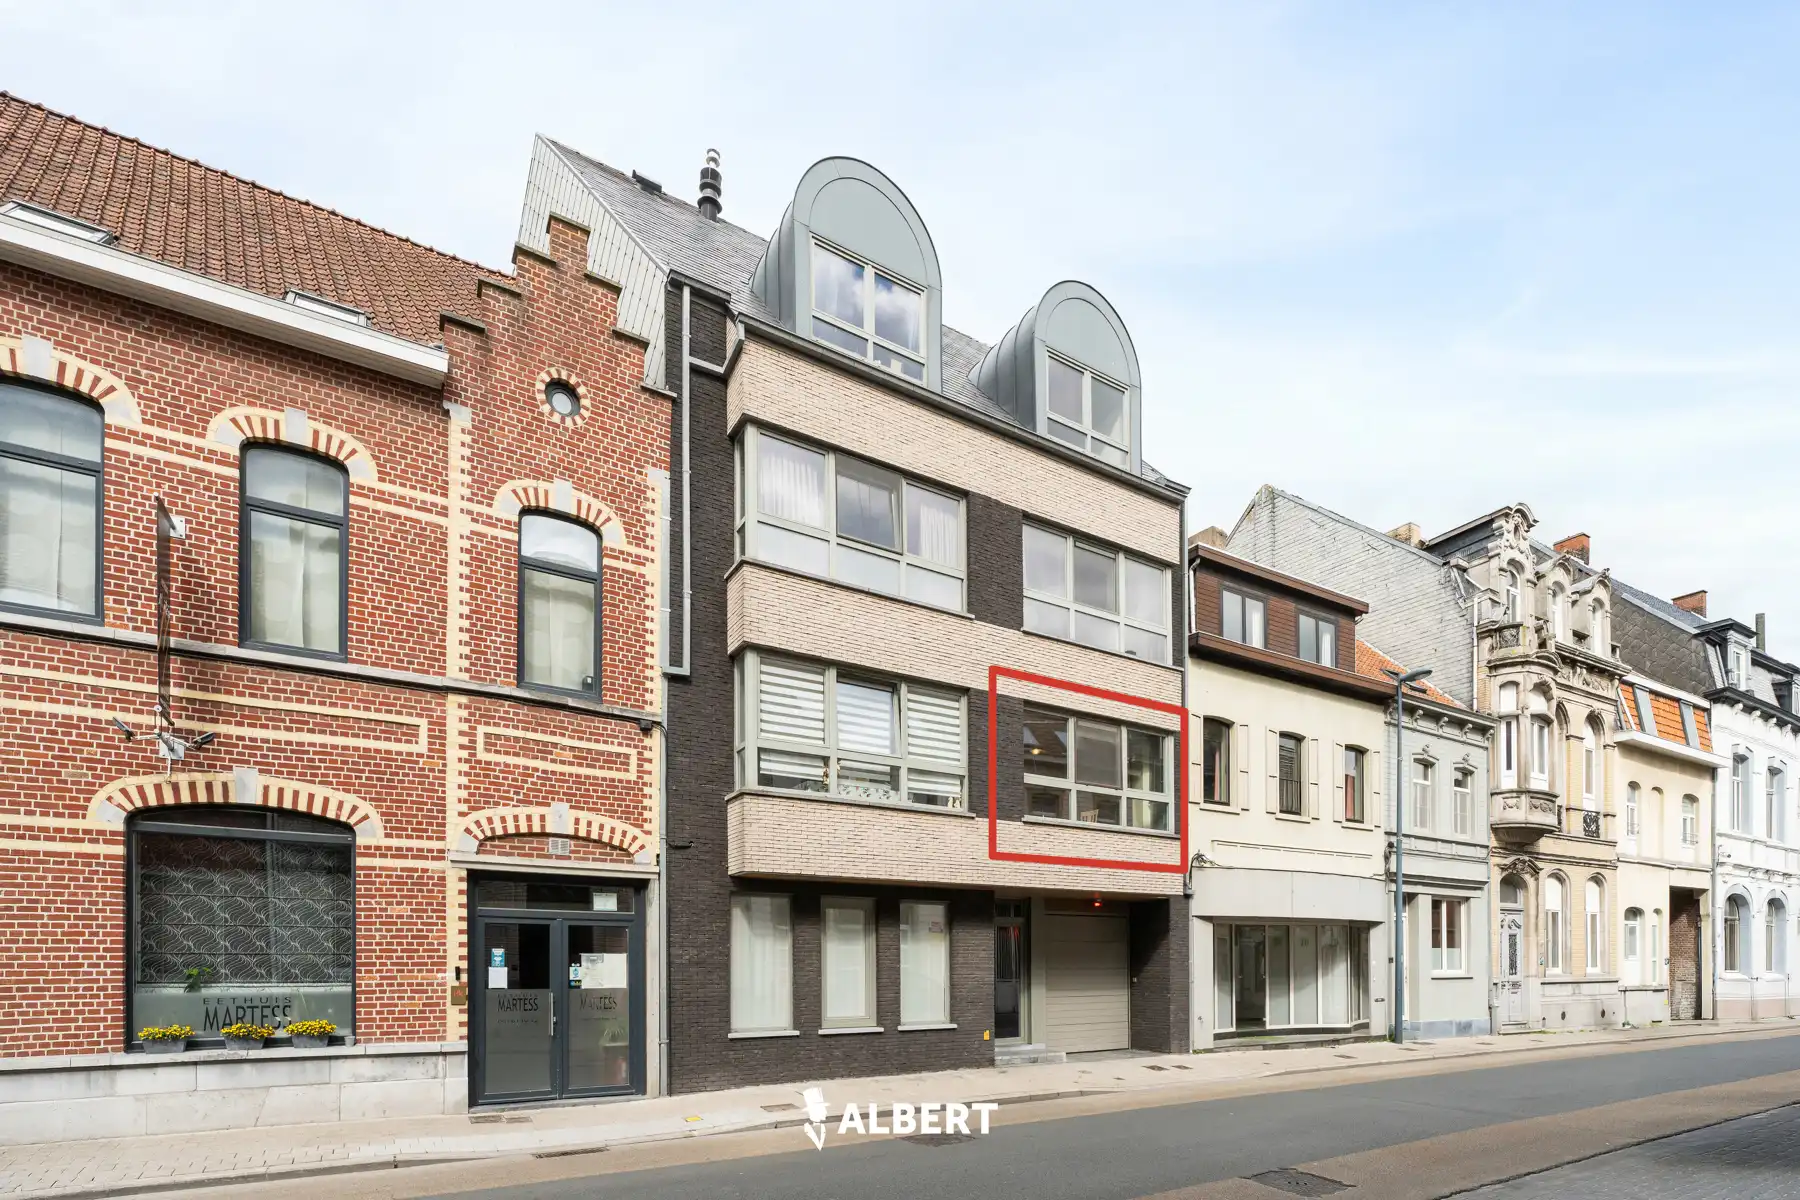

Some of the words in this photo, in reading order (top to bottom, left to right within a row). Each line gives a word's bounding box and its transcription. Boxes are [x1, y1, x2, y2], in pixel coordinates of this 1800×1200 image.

[203, 996, 291, 1005] EETHUIS
[497, 997, 539, 1012] MARTESS
[203, 1005, 292, 1031] MARTESS
